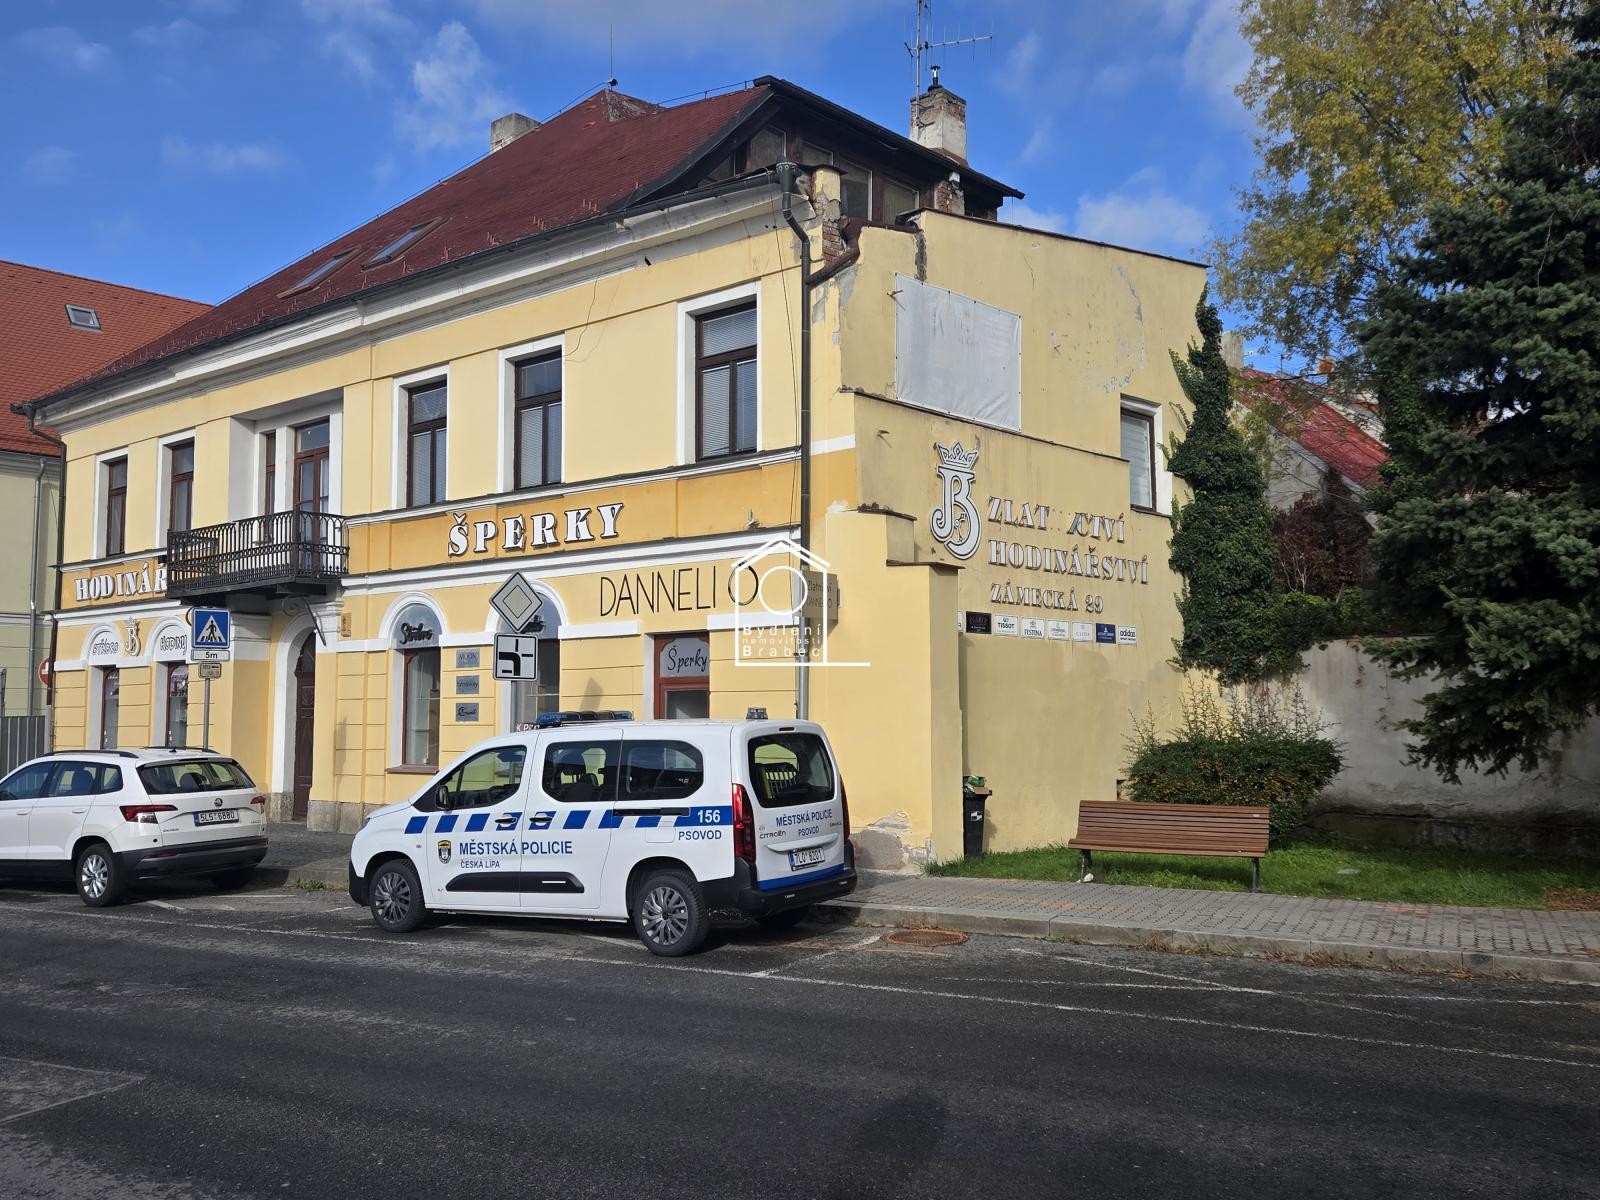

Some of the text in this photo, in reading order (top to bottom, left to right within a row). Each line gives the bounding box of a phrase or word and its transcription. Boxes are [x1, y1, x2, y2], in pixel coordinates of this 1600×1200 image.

[448, 503, 623, 557] ŠPERKY
[988, 540, 1148, 585] HODINÁŘSTVÍ
[990, 578, 1104, 613] ZÁMECKÁ 29
[668, 646, 708, 673] Šperky
[697, 809, 721, 823] 156
[776, 808, 833, 827] MĚSTSKÁ POLICIE
[678, 829, 722, 840] PSOVOD
[798, 825, 820, 837] PSOVOD
[459, 839, 573, 855] MĚSTSKÁ POLICIE
[460, 859, 500, 869] ČESKÁ LÍPA
